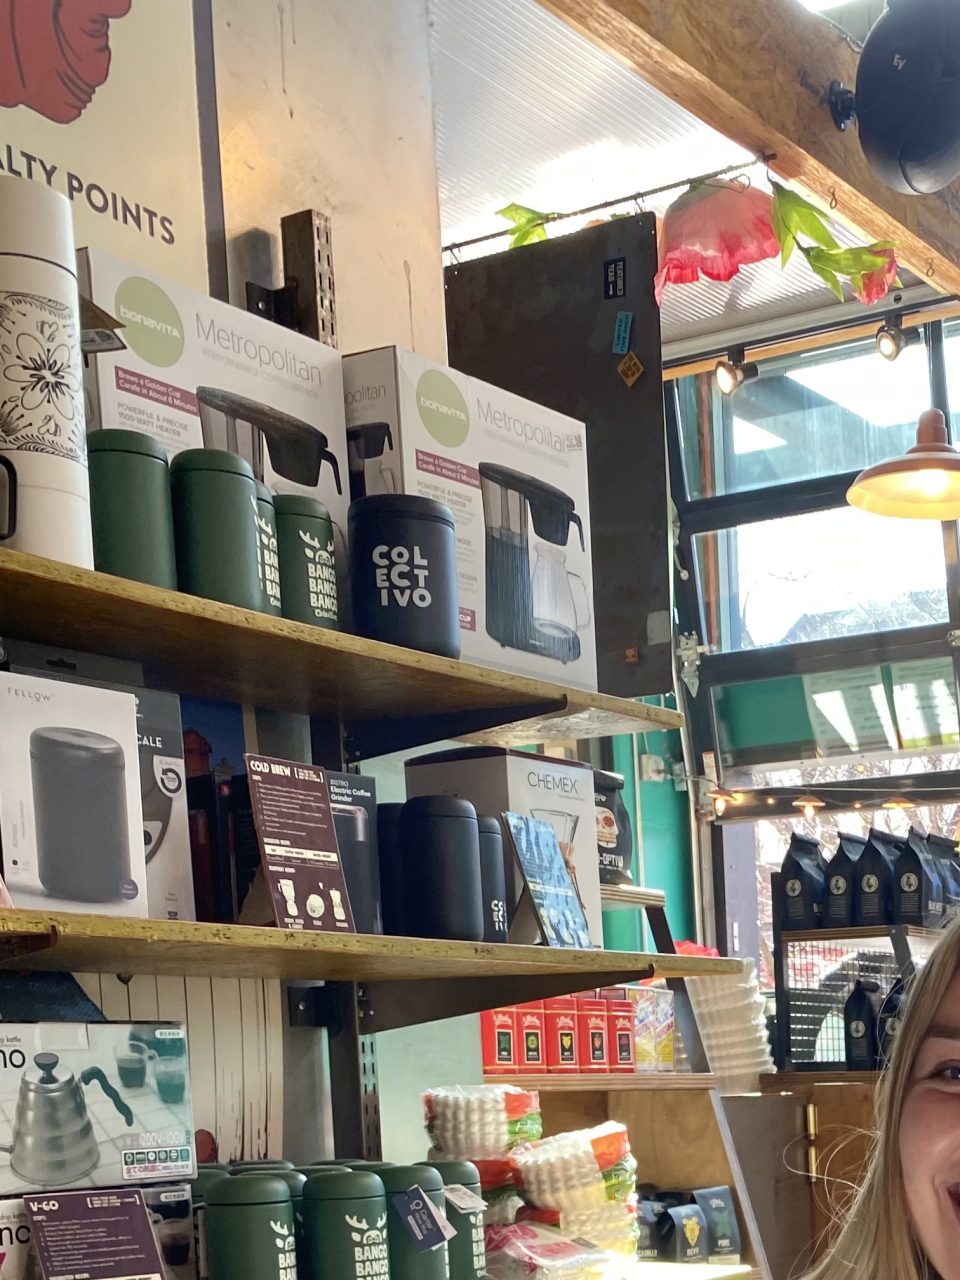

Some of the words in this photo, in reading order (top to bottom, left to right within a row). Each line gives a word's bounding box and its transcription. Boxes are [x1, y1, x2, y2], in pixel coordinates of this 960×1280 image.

[0, 144, 57, 187] LTY
[67, 172, 175, 245] POINTS
[196, 312, 322, 385] Metropolitan
[166, 387, 181, 400] Cup
[117, 402, 155, 419] POWERFUL
[155, 423, 182, 437] HEATER
[372, 544, 428, 567] COL
[375, 563, 429, 588] ECT
[381, 587, 432, 608] IVO
[7, 687, 51, 703] FELLOW
[250, 760, 270, 773] COLD
[270, 763, 291, 777] BREW
[330, 785, 352, 795] Electric
[527, 771, 579, 794] CHEMEX
[330, 794, 353, 803] Grinder
[354, 1243, 388, 1261] BANGO
[355, 1259, 389, 1276] BANGO
